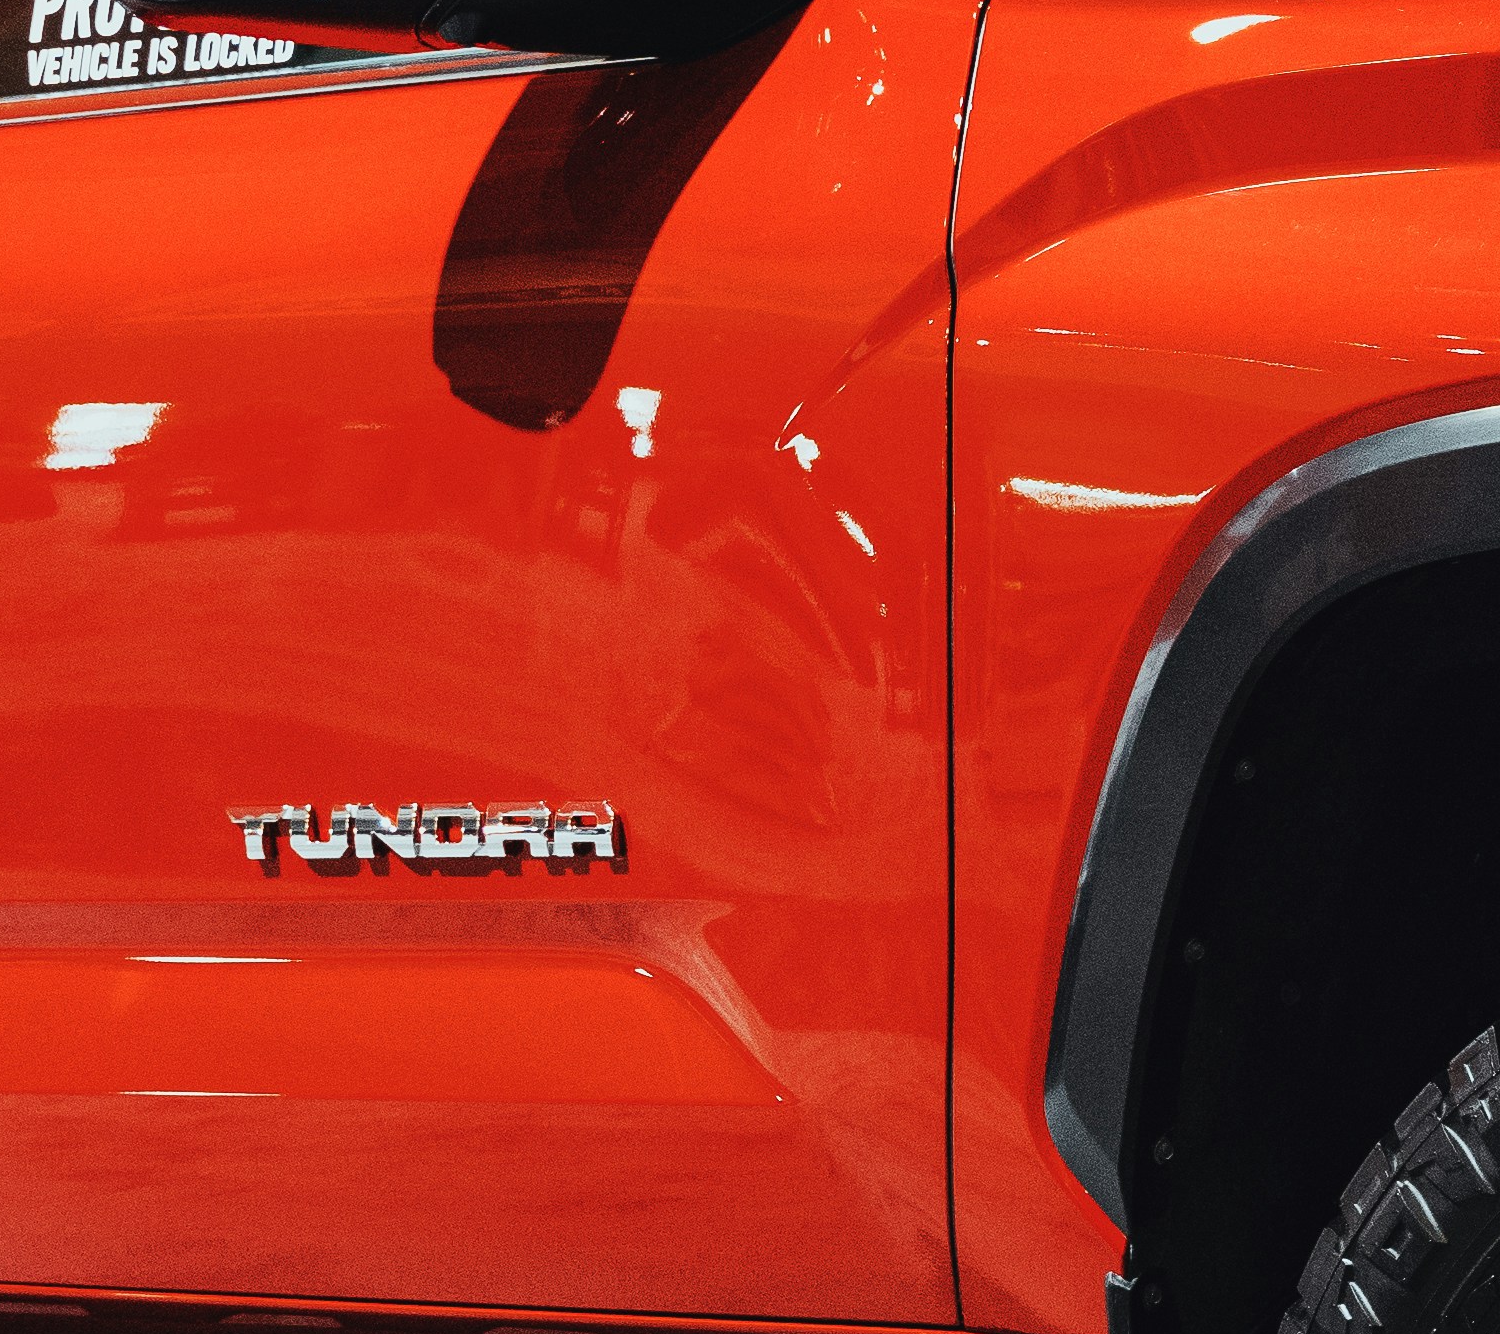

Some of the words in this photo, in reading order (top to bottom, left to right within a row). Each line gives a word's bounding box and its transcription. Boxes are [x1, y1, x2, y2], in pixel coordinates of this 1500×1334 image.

[28, 40, 143, 86] VEHICLE
[147, 36, 179, 75] IS
[184, 32, 296, 72] LOCKED
[225, 800, 617, 860] TUNDRA
